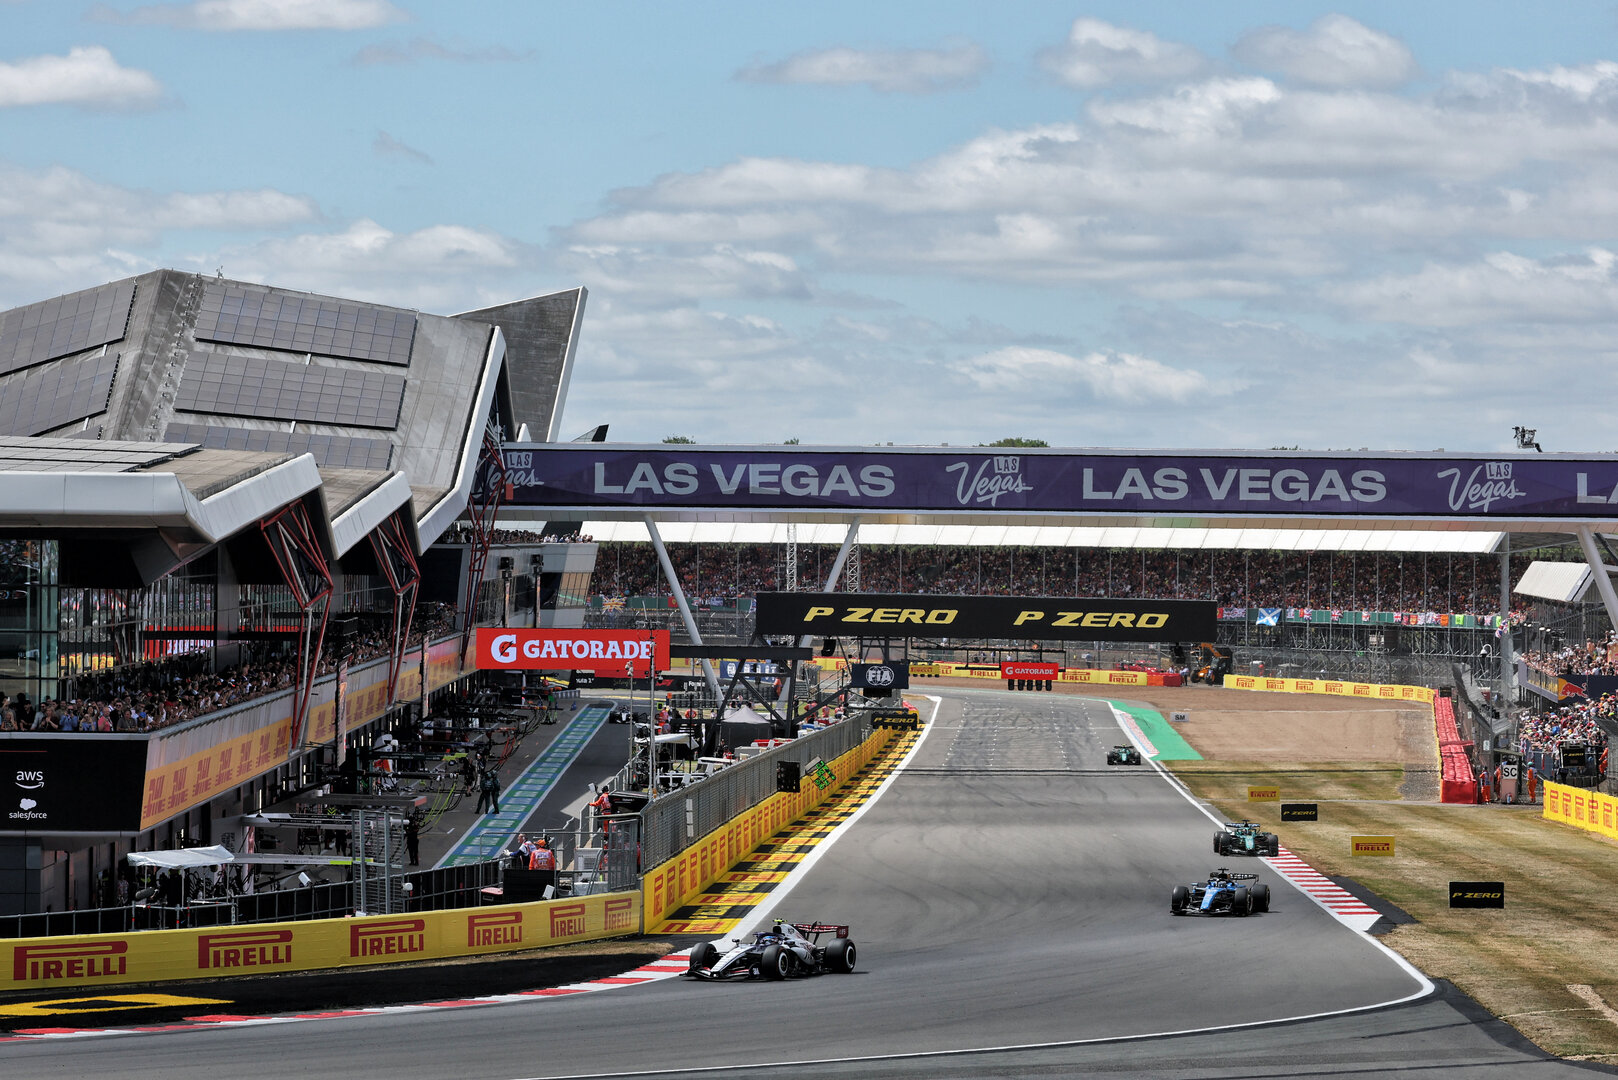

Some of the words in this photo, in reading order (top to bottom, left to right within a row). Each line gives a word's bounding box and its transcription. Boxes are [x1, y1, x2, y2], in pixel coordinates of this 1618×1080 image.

[508, 452, 531, 467] LAS
[996, 457, 1018, 472] LAS
[1487, 463, 1511, 478] LAS
[594, 462, 699, 495] LAS
[710, 463, 896, 498] VEGAS
[946, 459, 1034, 507] Vegas
[1083, 467, 1189, 500] LAS
[1199, 468, 1387, 502] VEGAS
[1437, 465, 1527, 513] Vegas
[1576, 472, 1618, 504] L
[804, 607, 834, 622] P
[841, 608, 959, 625] ZERO
[1013, 611, 1045, 626] P
[1051, 612, 1170, 629] ZERO
[522, 640, 651, 659] GATORADE
[868, 668, 893, 683] FIA
[1062, 671, 1091, 681] PIRELLI
[1109, 673, 1138, 683] PIRELLI
[16, 770, 44, 781] aws
[1503, 767, 1517, 777] SC
[8, 811, 48, 821] salesforce
[1355, 843, 1390, 851] PIRELLI
[550, 903, 586, 938] PIRELLI
[604, 897, 632, 931] PIRELLI
[350, 919, 425, 957] PIRELLI
[467, 911, 522, 947] PIRELLI
[197, 929, 293, 969] PIRELLI
[13, 940, 128, 981] PIRELLI
